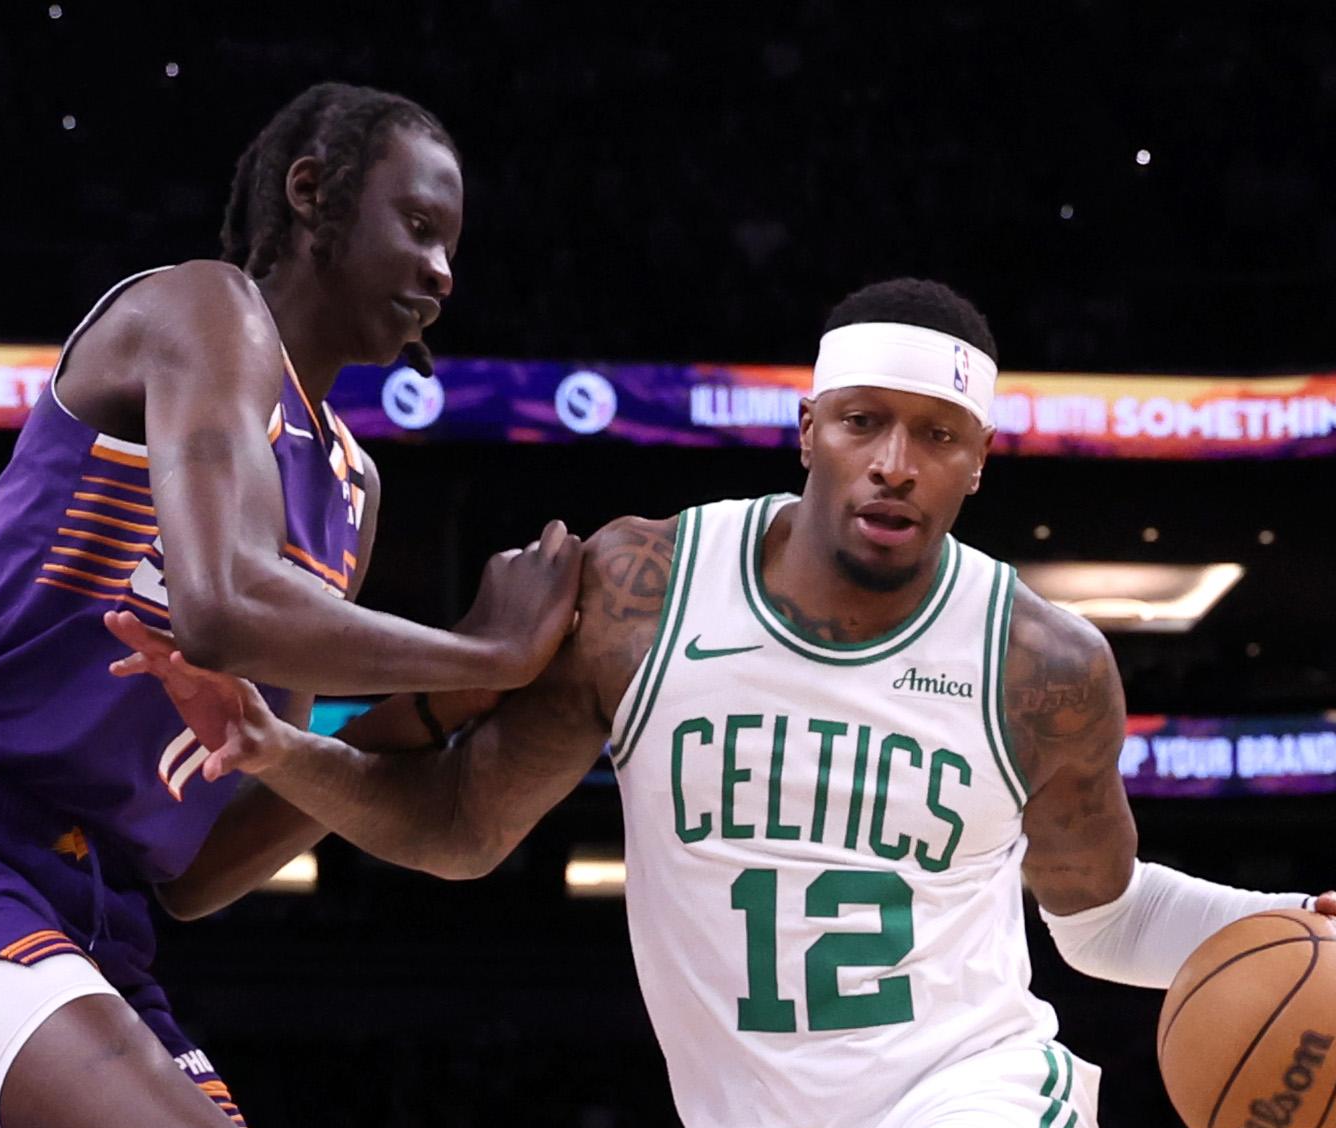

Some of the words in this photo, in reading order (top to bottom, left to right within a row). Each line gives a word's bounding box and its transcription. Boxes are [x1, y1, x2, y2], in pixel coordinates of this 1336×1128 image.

[892, 667, 974, 699] Amica
[671, 714, 972, 873] CELTICS
[1151, 735, 1233, 779] YOUR
[730, 868, 915, 1033] 12
